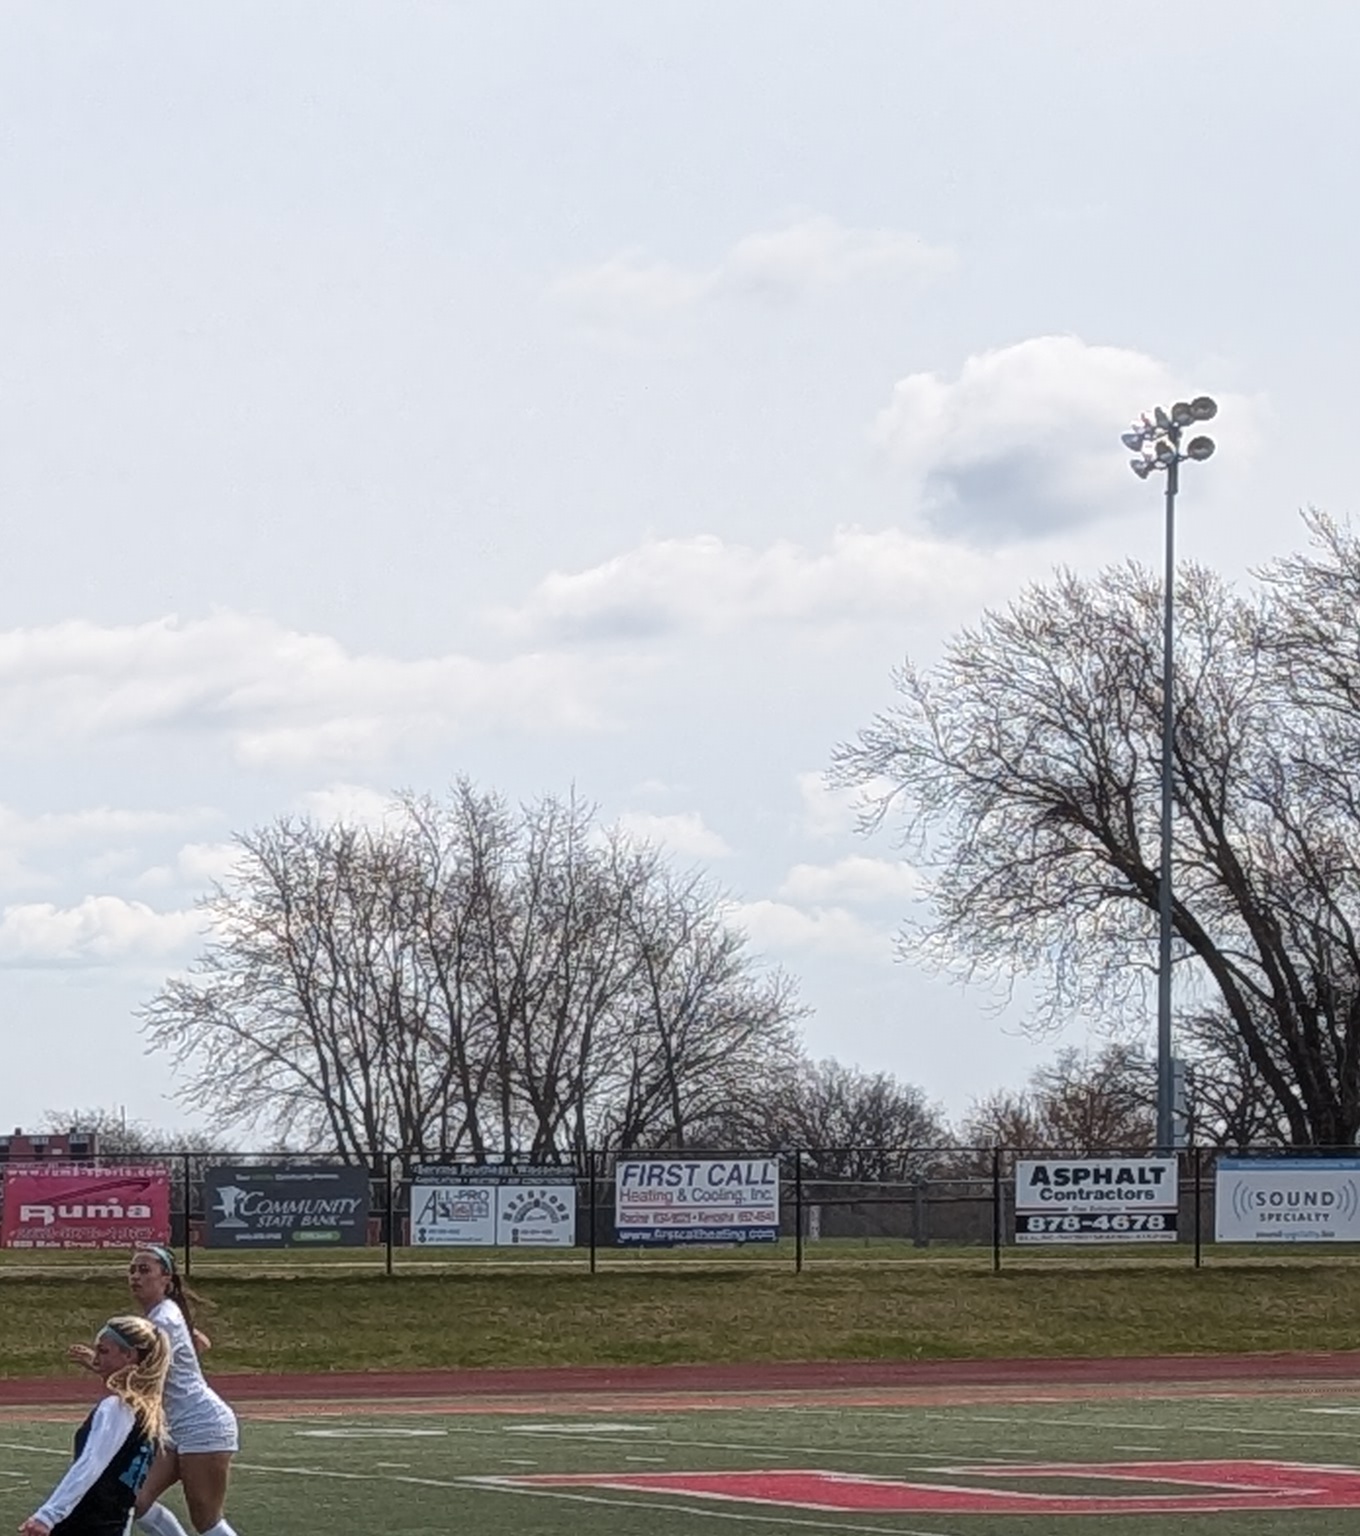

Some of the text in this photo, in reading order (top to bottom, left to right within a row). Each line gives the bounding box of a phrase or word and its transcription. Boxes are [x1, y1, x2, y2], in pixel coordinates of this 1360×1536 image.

[622, 1163, 775, 1187] FIRST CALL
[1030, 1166, 1166, 1186] ASPHALT
[620, 1188, 673, 1205] Heating
[677, 1188, 687, 1201] &
[751, 1188, 773, 1201] Inc.
[1040, 1188, 1155, 1201] Contractors
[1256, 1191, 1335, 1206] SOUND
[240, 1191, 362, 1215] COMMUNITY
[256, 1215, 294, 1227] STATE
[301, 1215, 339, 1226] BANK
[1027, 1215, 1165, 1231] 878-4678
[1260, 1212, 1330, 1222] SPECIALTY
